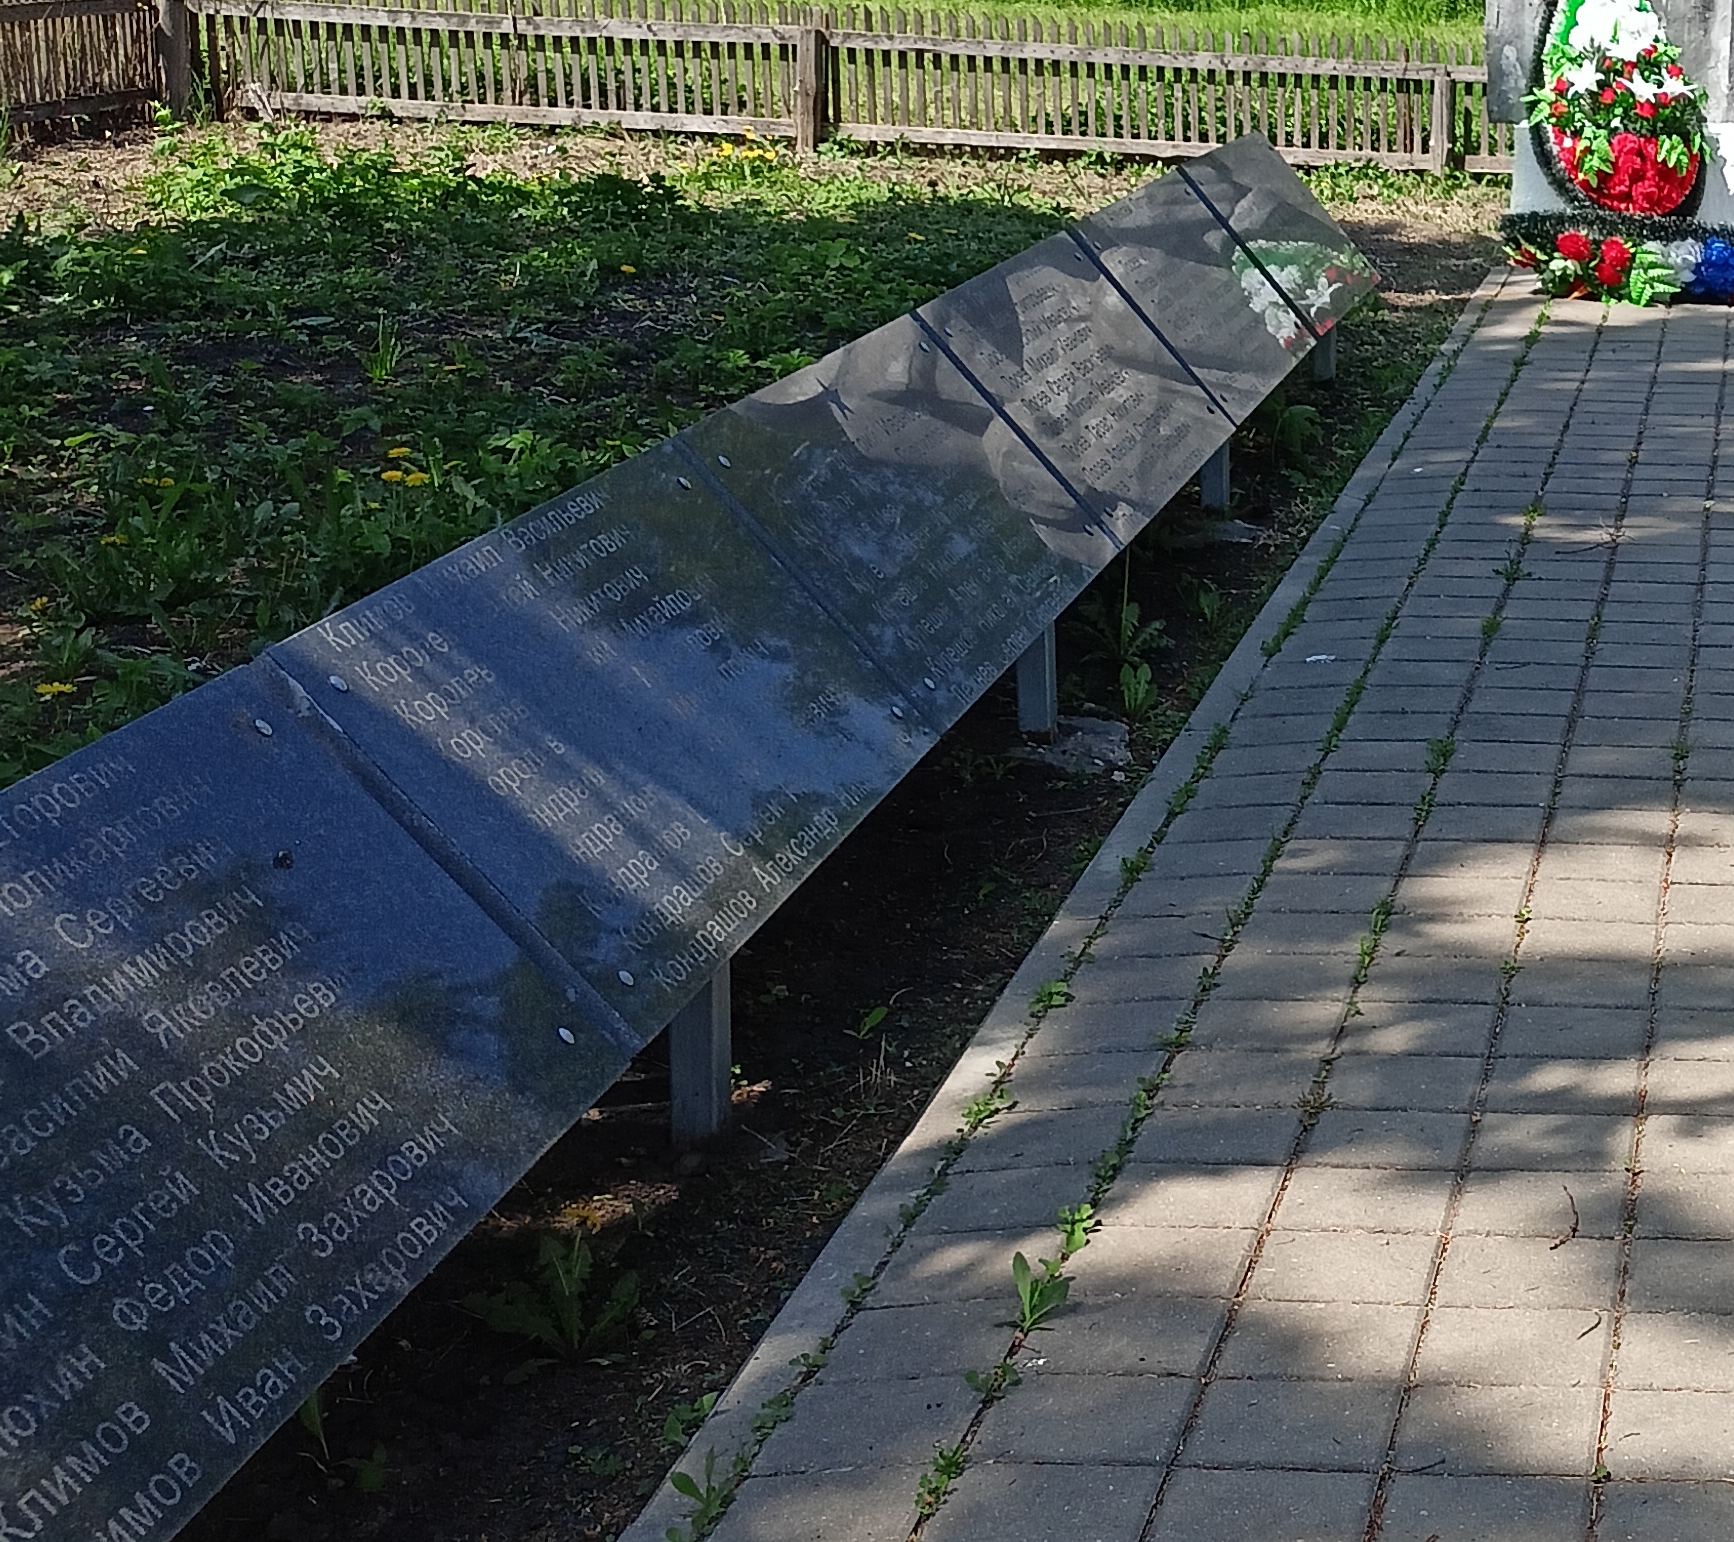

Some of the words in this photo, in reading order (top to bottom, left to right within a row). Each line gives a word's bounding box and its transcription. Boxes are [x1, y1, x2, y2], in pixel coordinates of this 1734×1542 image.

[0, 1036, 143, 1168] асилий
[0, 1124, 152, 1242] Кузьма
[53, 1159, 203, 1289] Сергей
[195, 1055, 344, 1175] Кузьмич
[107, 1225, 240, 1338] Фёдор
[233, 1089, 397, 1229] Иванович
[147, 1257, 303, 1397] Михаил
[291, 1109, 457, 1259] Захарович
[198, 1345, 311, 1449] Иван
[301, 1184, 470, 1346] Захарович
